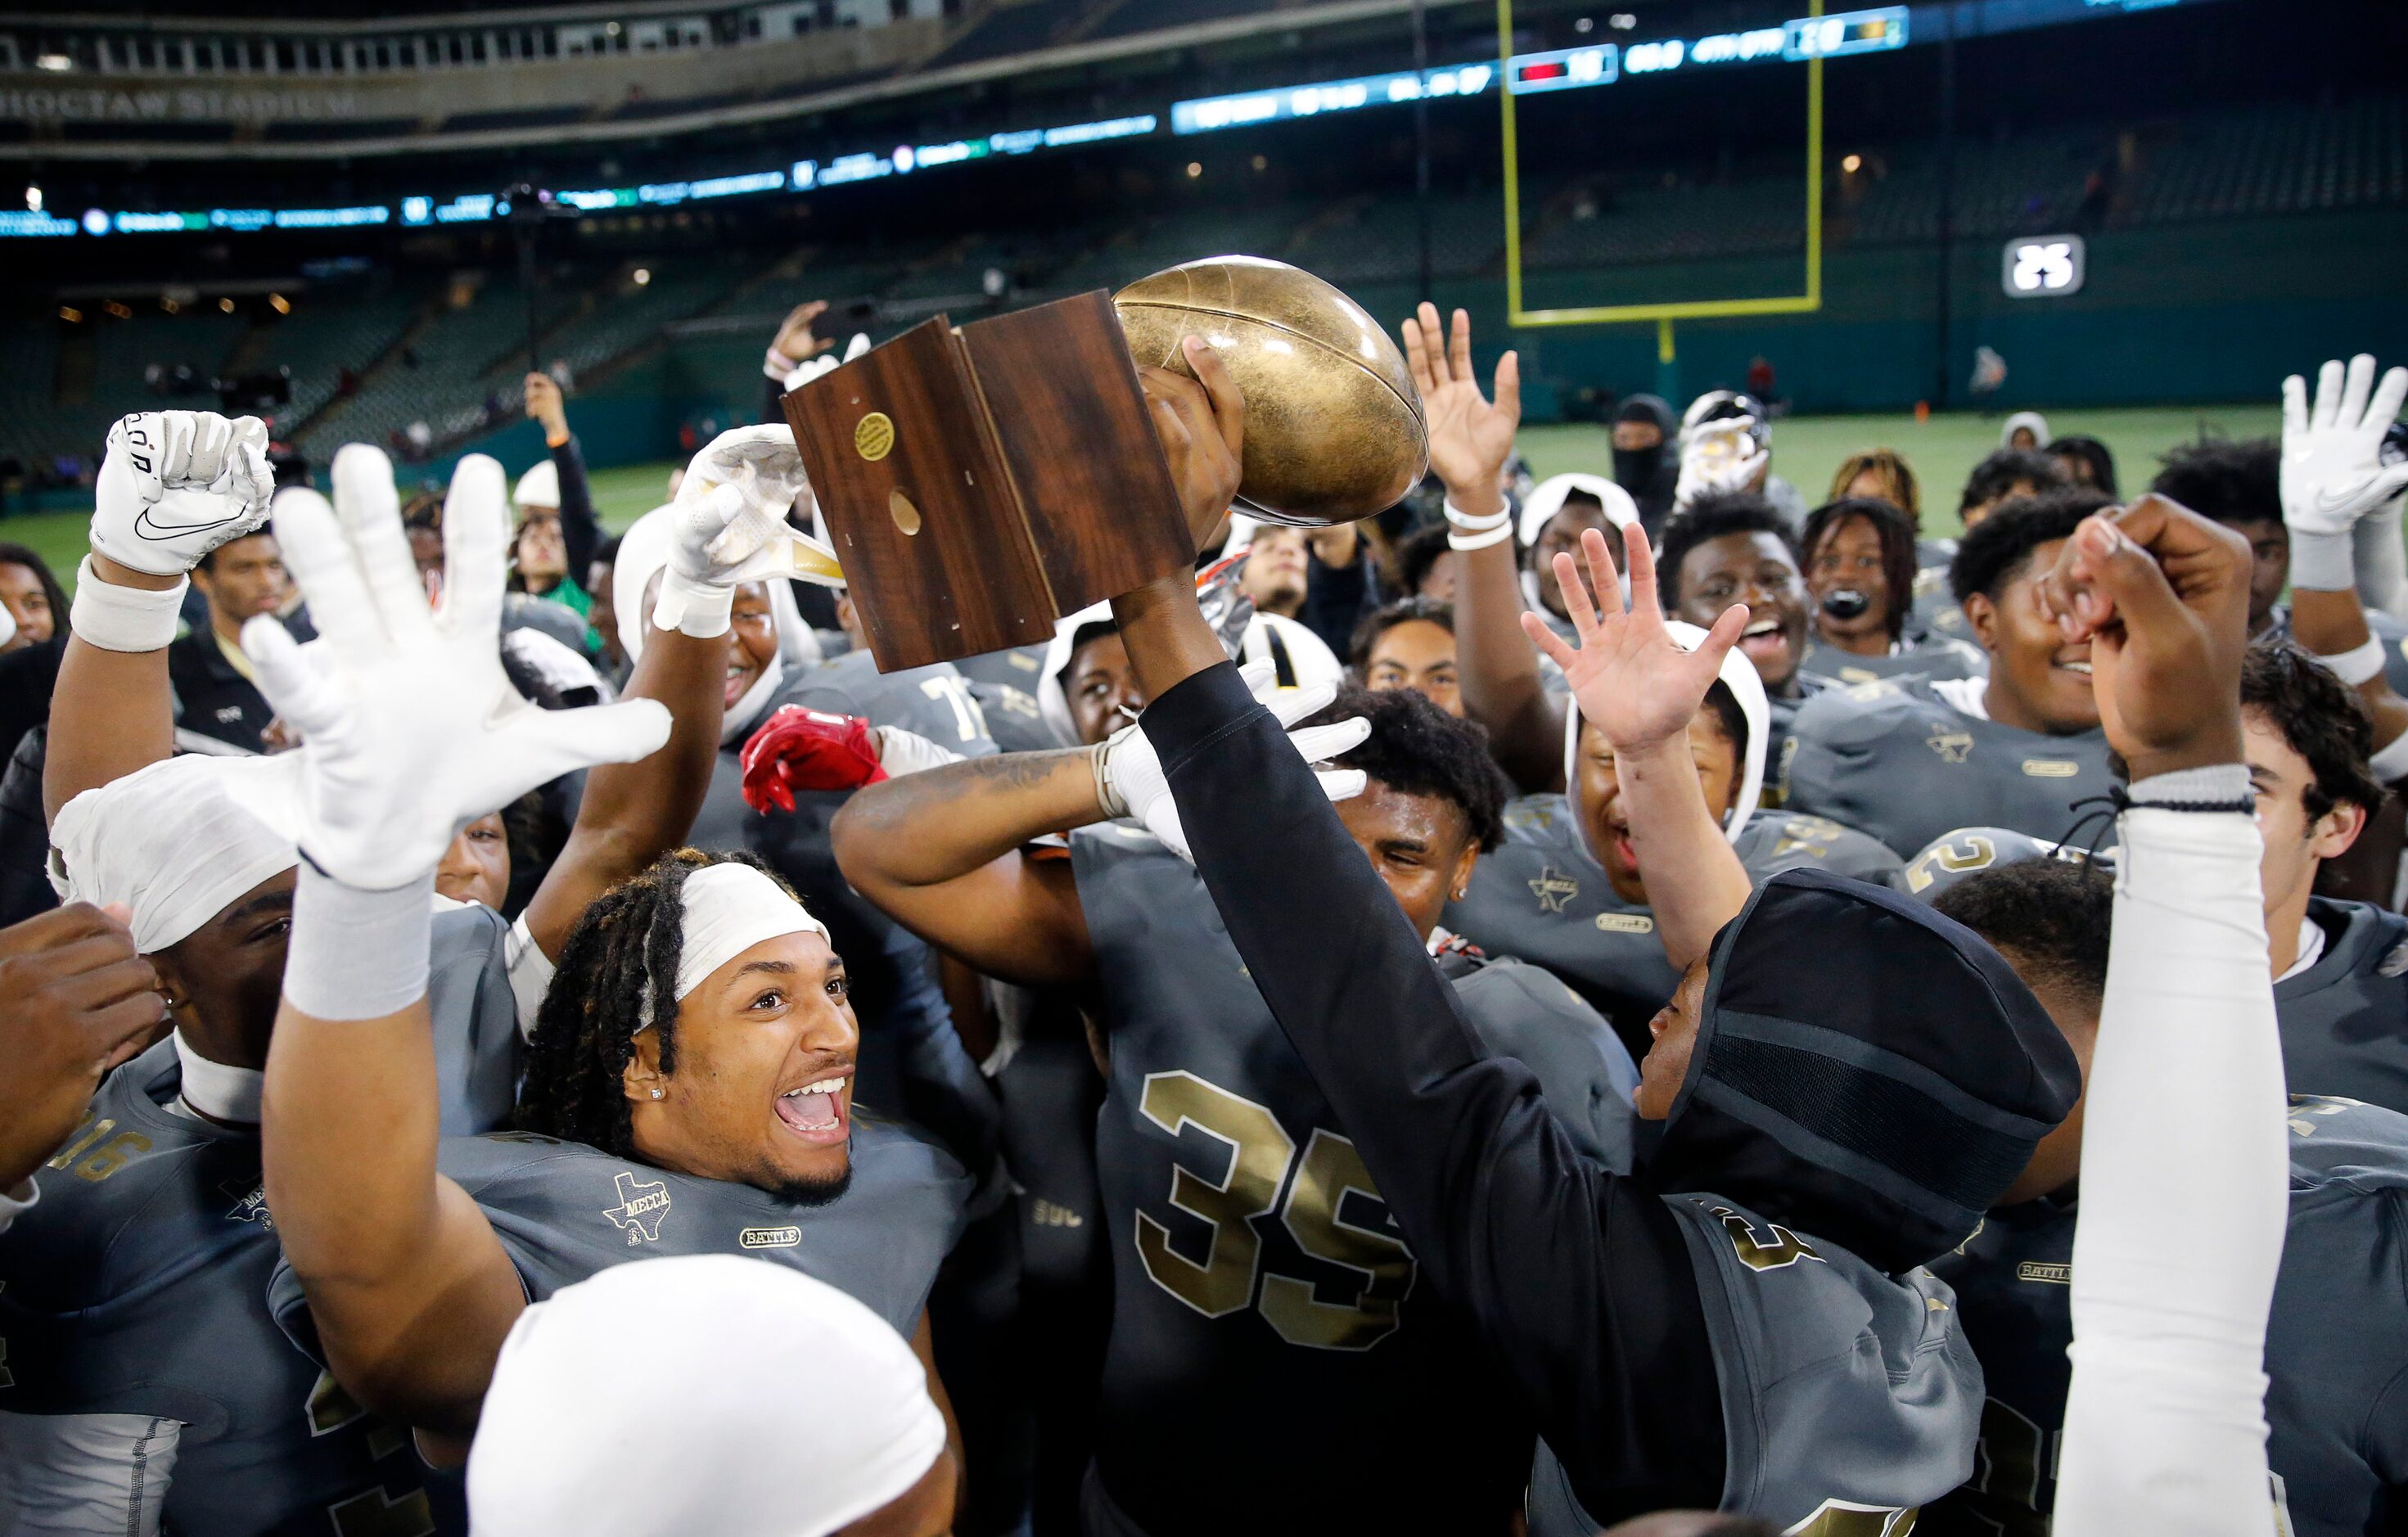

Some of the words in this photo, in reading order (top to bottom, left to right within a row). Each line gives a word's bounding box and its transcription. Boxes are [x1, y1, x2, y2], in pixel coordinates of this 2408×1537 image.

[625, 1190, 670, 1218] MECCA
[1134, 1070, 1418, 1352] 35
[746, 1229, 798, 1246] BATTLE
